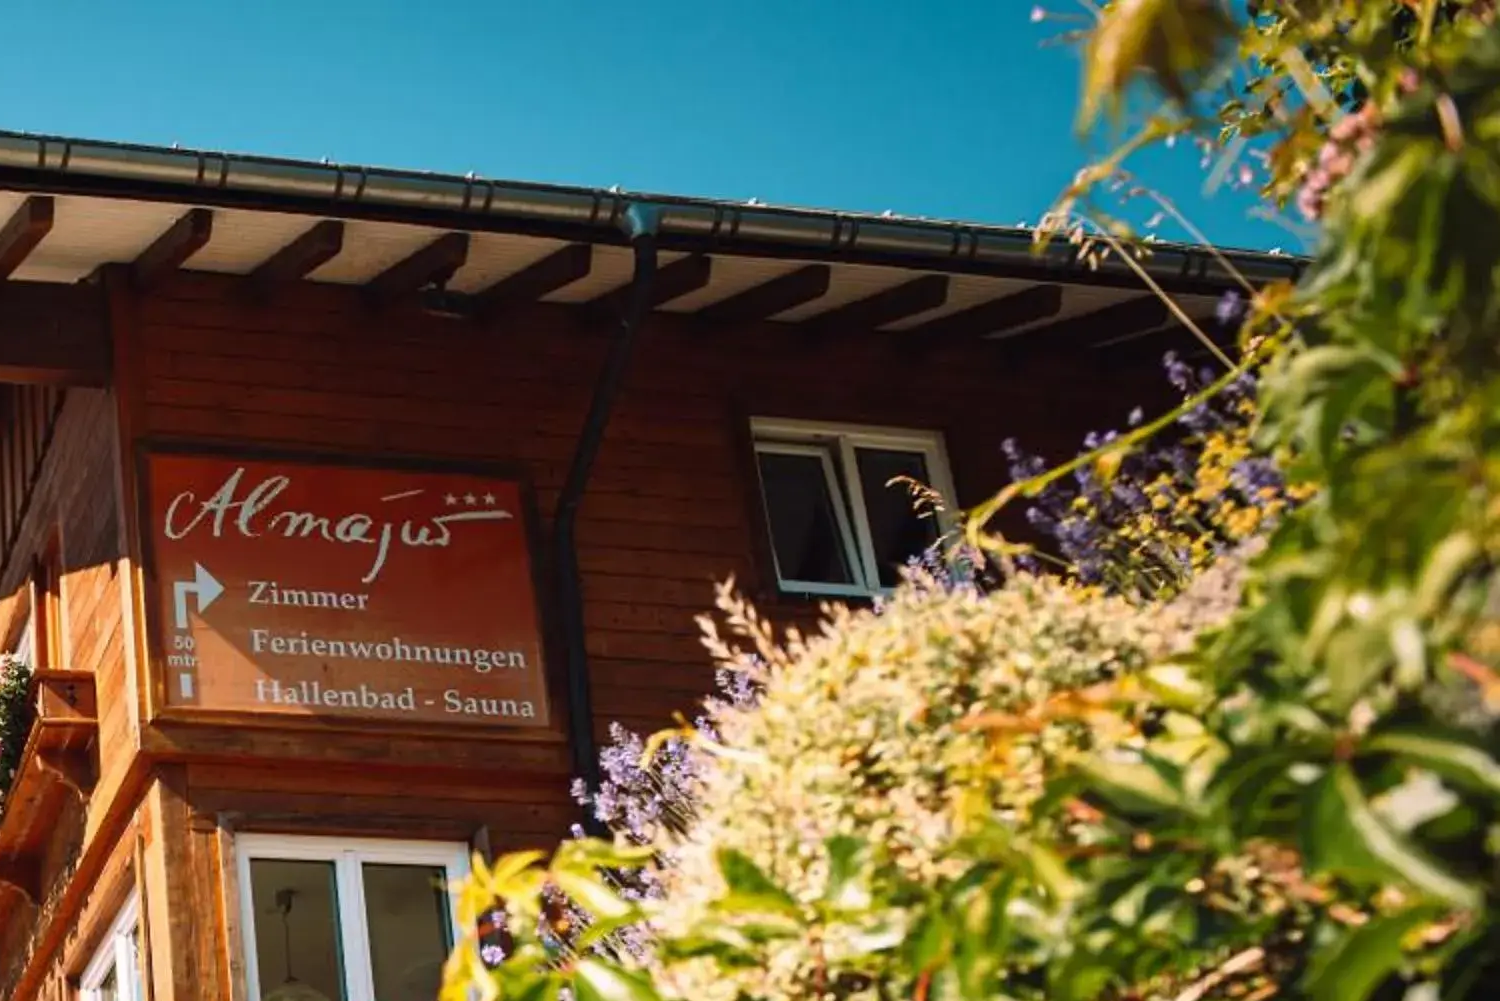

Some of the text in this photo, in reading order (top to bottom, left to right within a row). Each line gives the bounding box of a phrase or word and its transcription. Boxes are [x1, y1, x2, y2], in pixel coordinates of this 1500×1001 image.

[248, 580, 369, 610] Zimmer
[172, 635, 195, 651] 50
[251, 629, 527, 674] Ferienwohnungen
[254, 678, 416, 711] Hallenbad
[443, 692, 536, 718] Sauna
